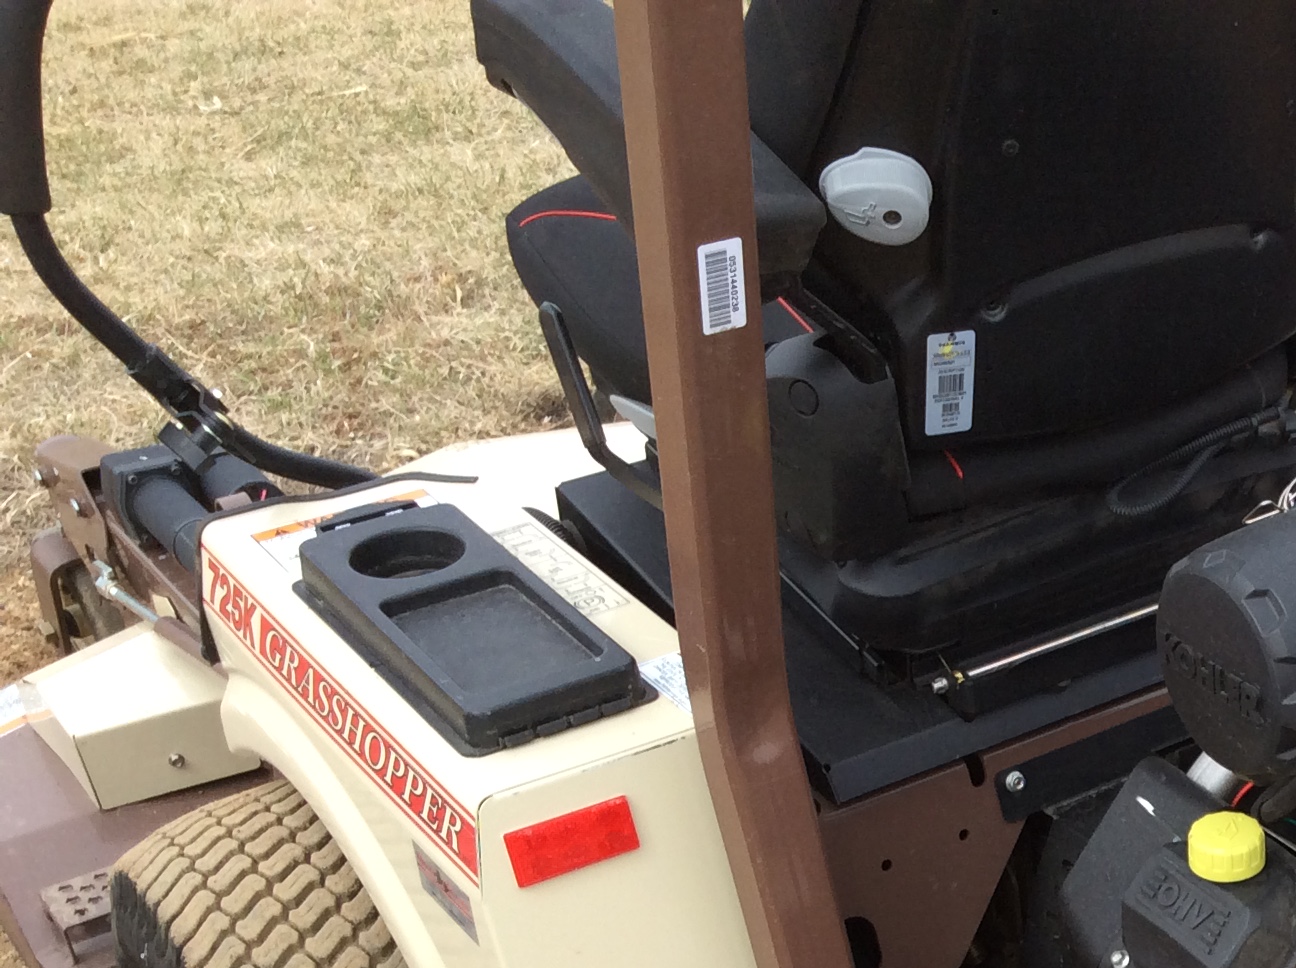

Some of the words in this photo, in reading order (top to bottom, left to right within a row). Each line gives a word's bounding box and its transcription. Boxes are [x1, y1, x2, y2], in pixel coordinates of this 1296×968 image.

[728, 255, 740, 313] 0531440238
[207, 557, 257, 651] 725K
[265, 629, 463, 855] GRASSHOPPER
